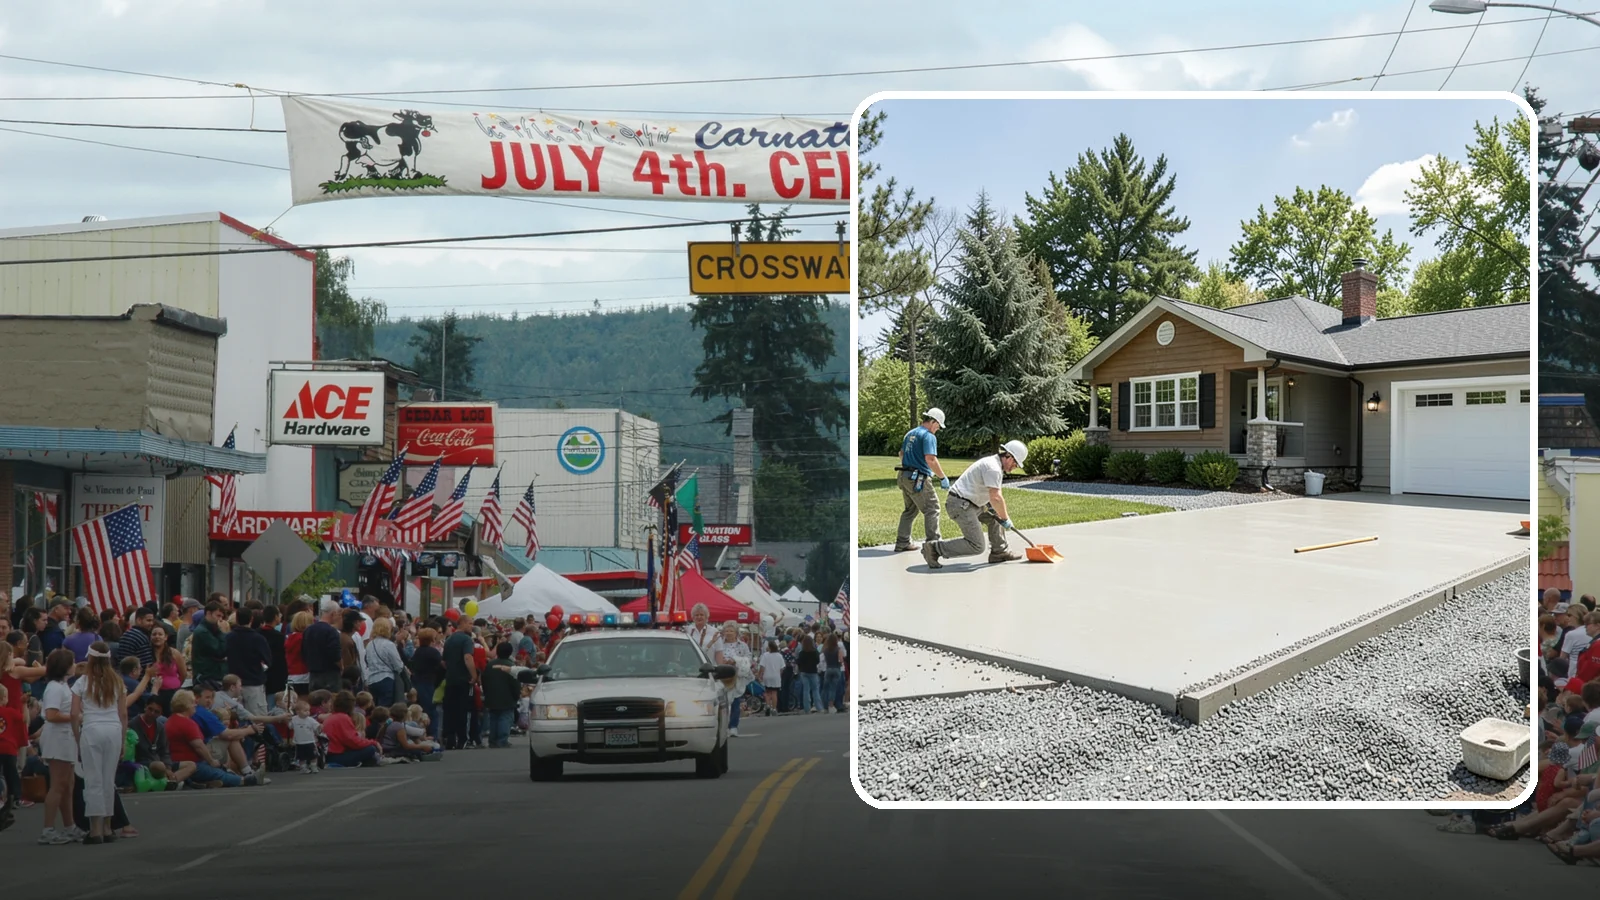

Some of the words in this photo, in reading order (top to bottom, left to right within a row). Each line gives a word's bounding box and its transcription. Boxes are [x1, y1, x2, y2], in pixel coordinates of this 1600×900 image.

[481, 140, 605, 193] JULY
[632, 149, 746, 198] 4th.
[697, 254, 850, 280] CROSSWA
[283, 380, 373, 420] ACE
[405, 409, 452, 422] CEDAR
[461, 409, 485, 422] LOG
[283, 421, 371, 437] Hardware
[416, 427, 477, 447] Coca-Cola
[353, 467, 384, 481] Simpl
[83, 485, 93, 494] St.
[96, 485, 124, 495] Vincent
[126, 486, 136, 495] de
[138, 486, 155, 495] Paul
[688, 526, 741, 535] CRNATION
[699, 535, 730, 544] GLASS
